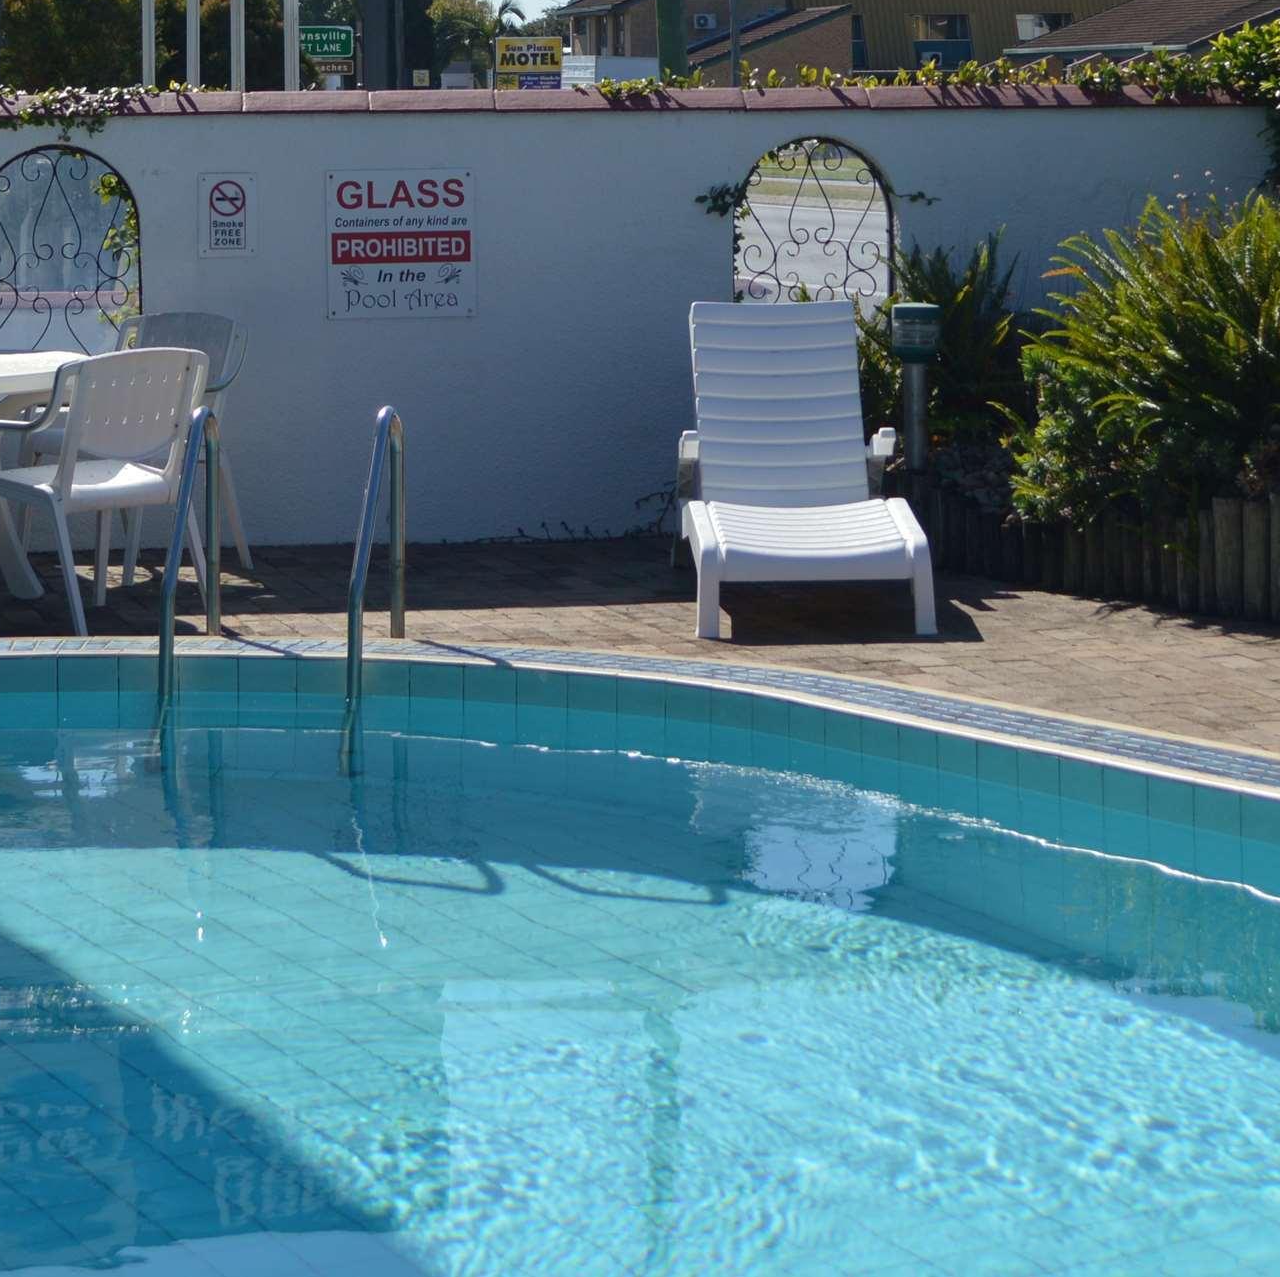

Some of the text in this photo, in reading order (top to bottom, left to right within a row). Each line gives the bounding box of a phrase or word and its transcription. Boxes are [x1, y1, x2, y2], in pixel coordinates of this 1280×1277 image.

[300, 31, 346, 41] wnsville
[300, 43, 342, 52] FT LANE
[505, 43, 554, 52] Sun Plaza
[500, 52, 560, 66] MOTEL
[336, 179, 465, 209] GLASS
[212, 220, 244, 228] Smoke
[335, 215, 468, 229] Containers of any kind are
[214, 229, 241, 237] FREE
[213, 237, 242, 246] ZONE
[336, 237, 466, 258] PROHIBITED
[377, 269, 426, 283] In the
[345, 288, 459, 312] Pool Area
